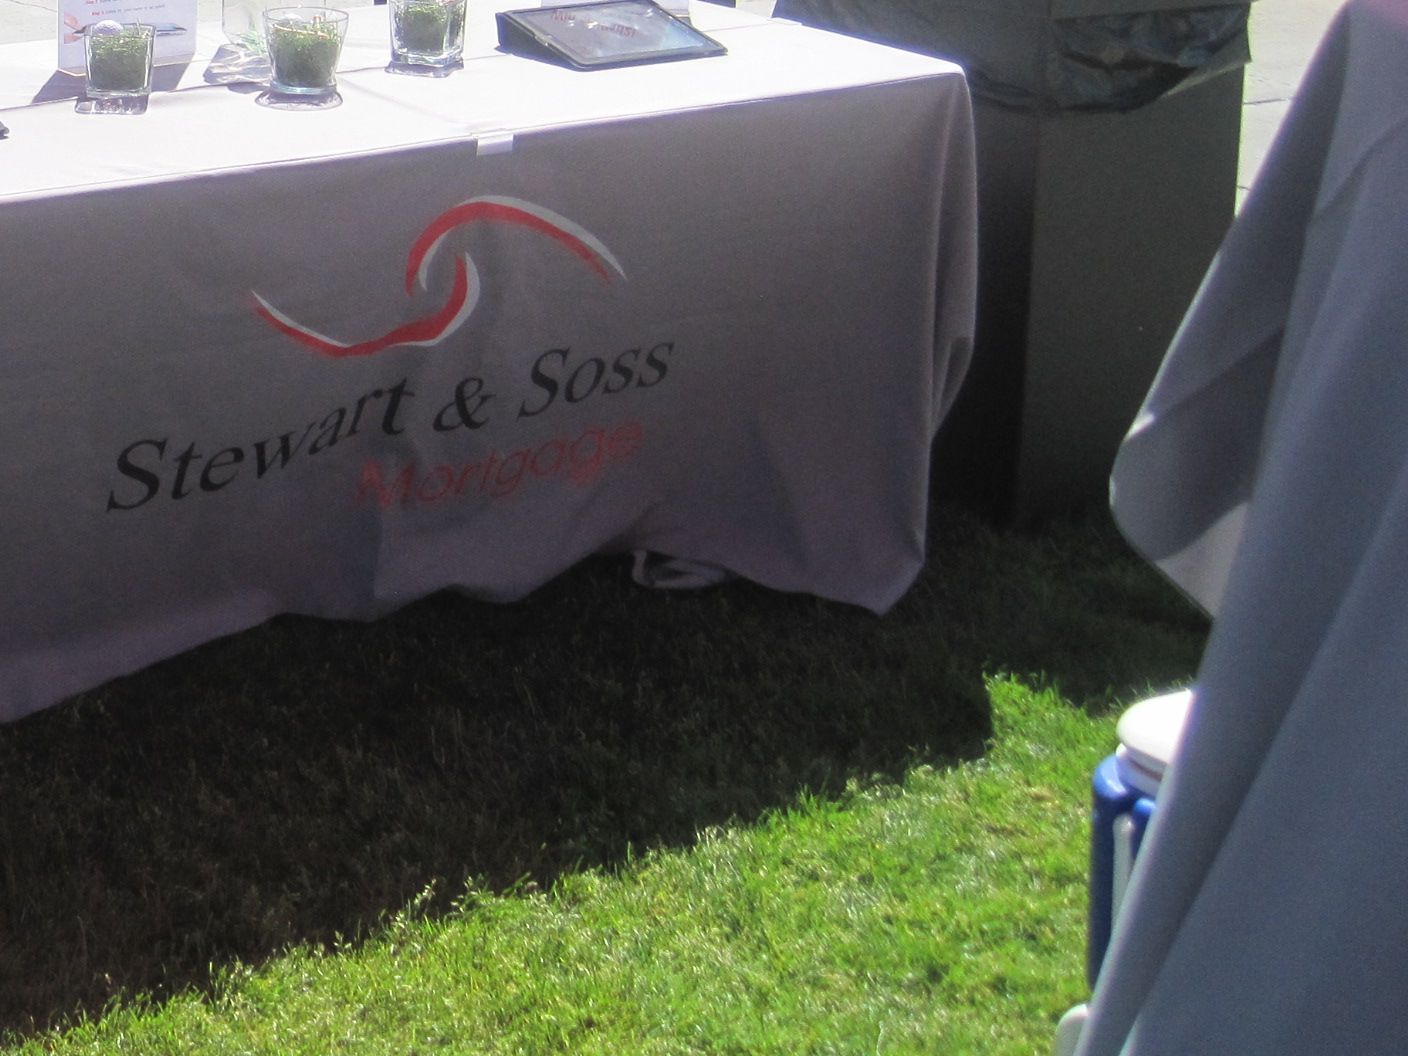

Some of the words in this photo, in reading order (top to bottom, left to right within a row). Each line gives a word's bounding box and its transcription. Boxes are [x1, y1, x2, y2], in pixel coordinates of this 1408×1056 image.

[105, 378, 415, 514] Stewart
[433, 377, 496, 433] &
[517, 342, 675, 422] Soss
[356, 419, 644, 510] Mortgage
